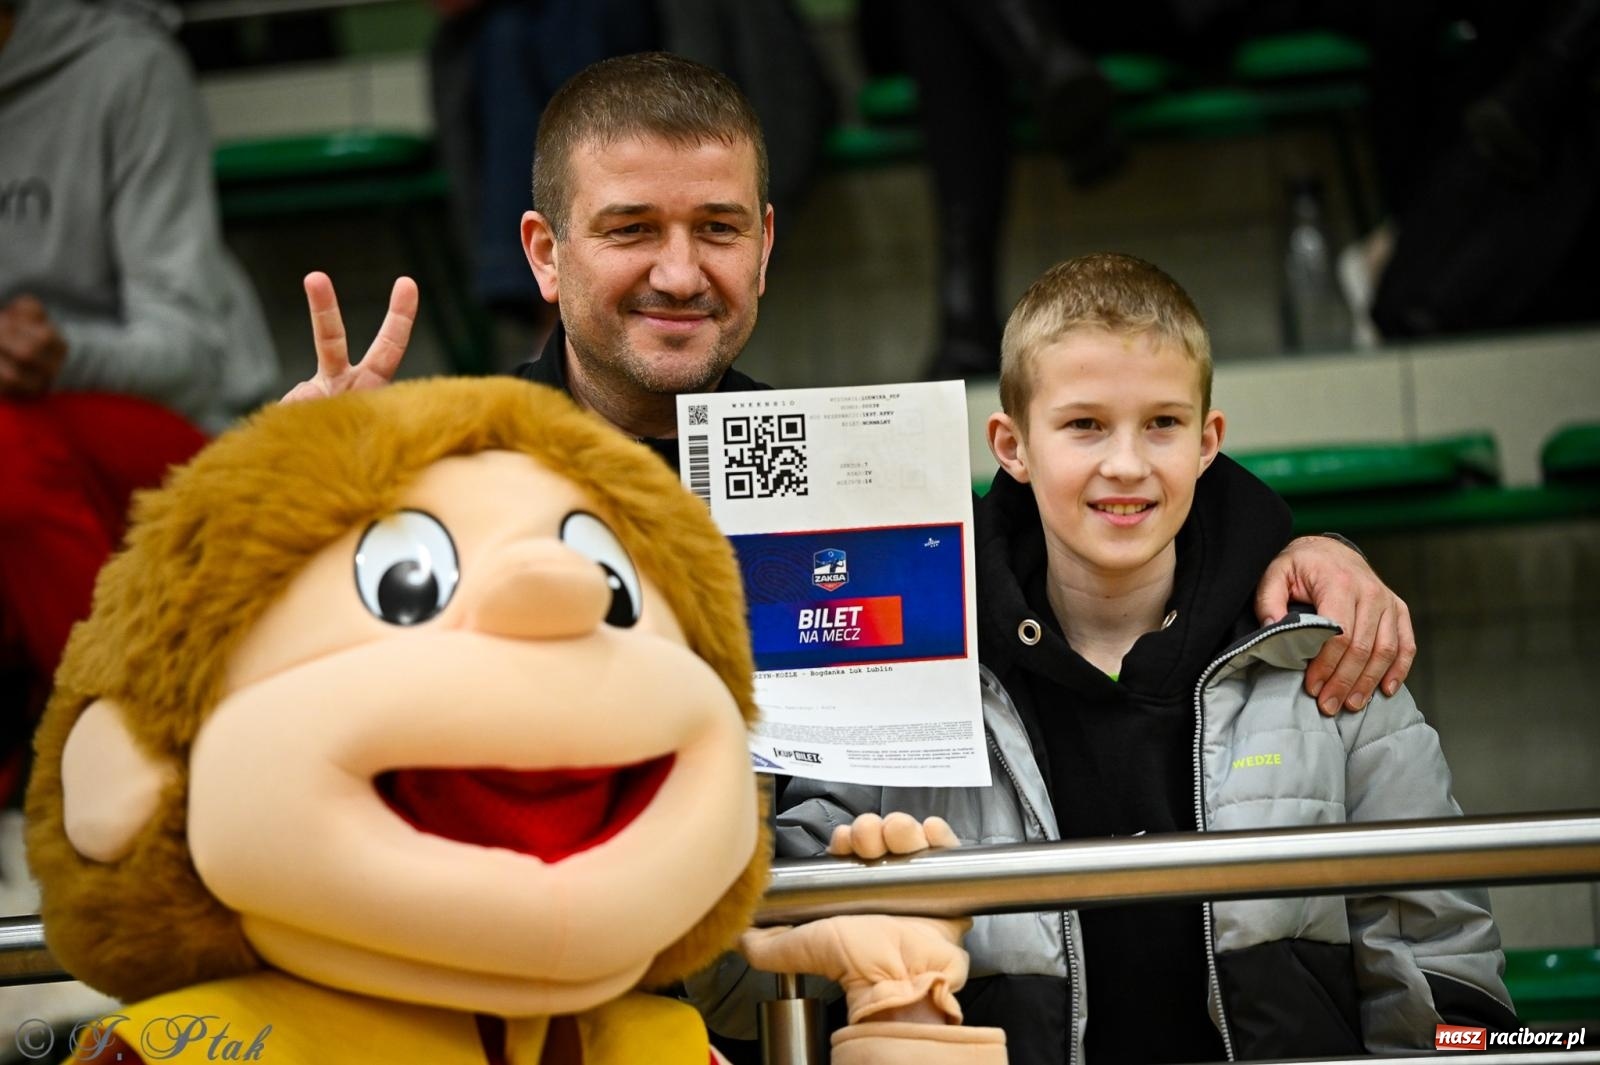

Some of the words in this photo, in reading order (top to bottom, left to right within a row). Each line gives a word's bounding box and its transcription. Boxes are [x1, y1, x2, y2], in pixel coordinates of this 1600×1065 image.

[814, 573, 846, 583] ZAKSA
[798, 605, 863, 630] BILET
[799, 630, 819, 644] NA
[822, 628, 861, 643] MECZ
[810, 669, 846, 677] Bogdanka
[866, 665, 893, 673] Lublin
